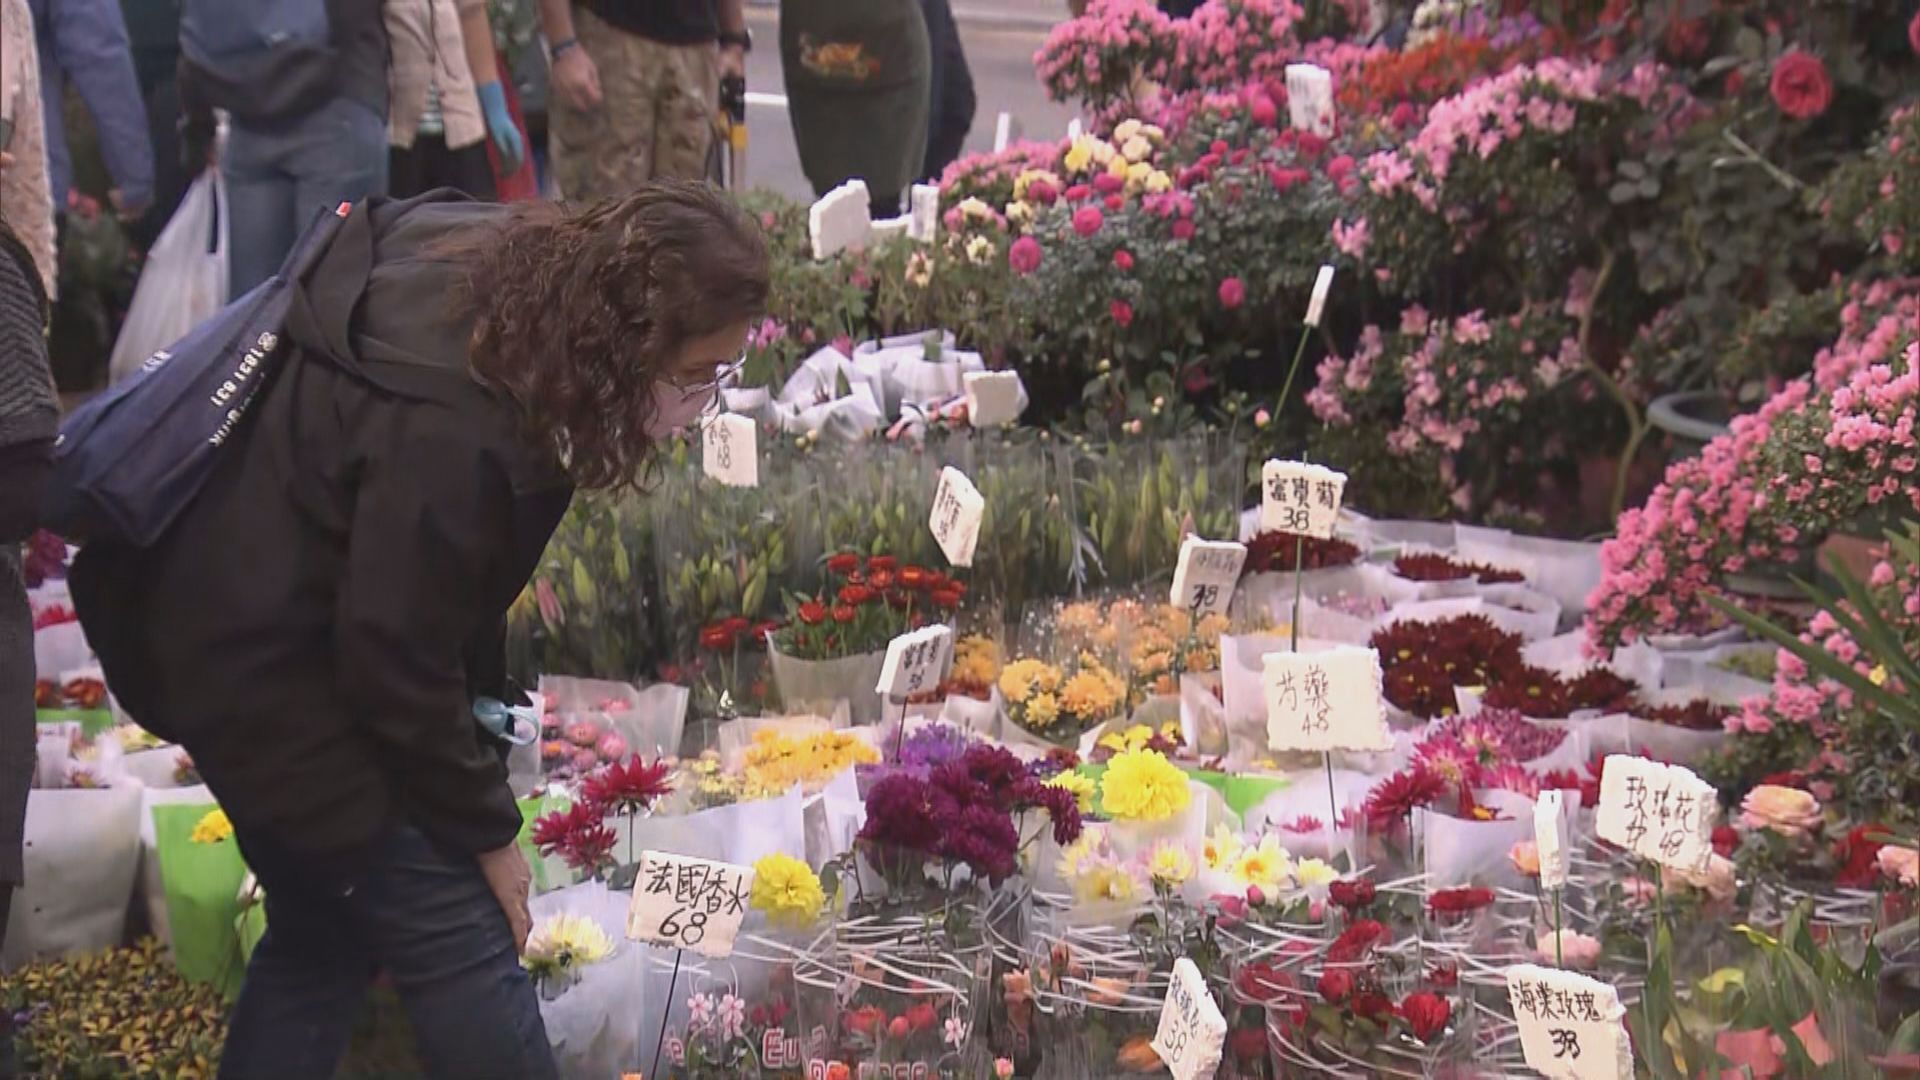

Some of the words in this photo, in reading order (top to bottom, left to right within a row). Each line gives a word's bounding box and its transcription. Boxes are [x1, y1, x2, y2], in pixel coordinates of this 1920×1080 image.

[1280, 506, 1310, 531] 38
[1302, 708, 1329, 736] 48
[645, 860, 750, 915] 法國香水
[659, 907, 708, 946] 68
[1165, 1019, 1187, 1063] 38
[1548, 1027, 1581, 1059] 38
